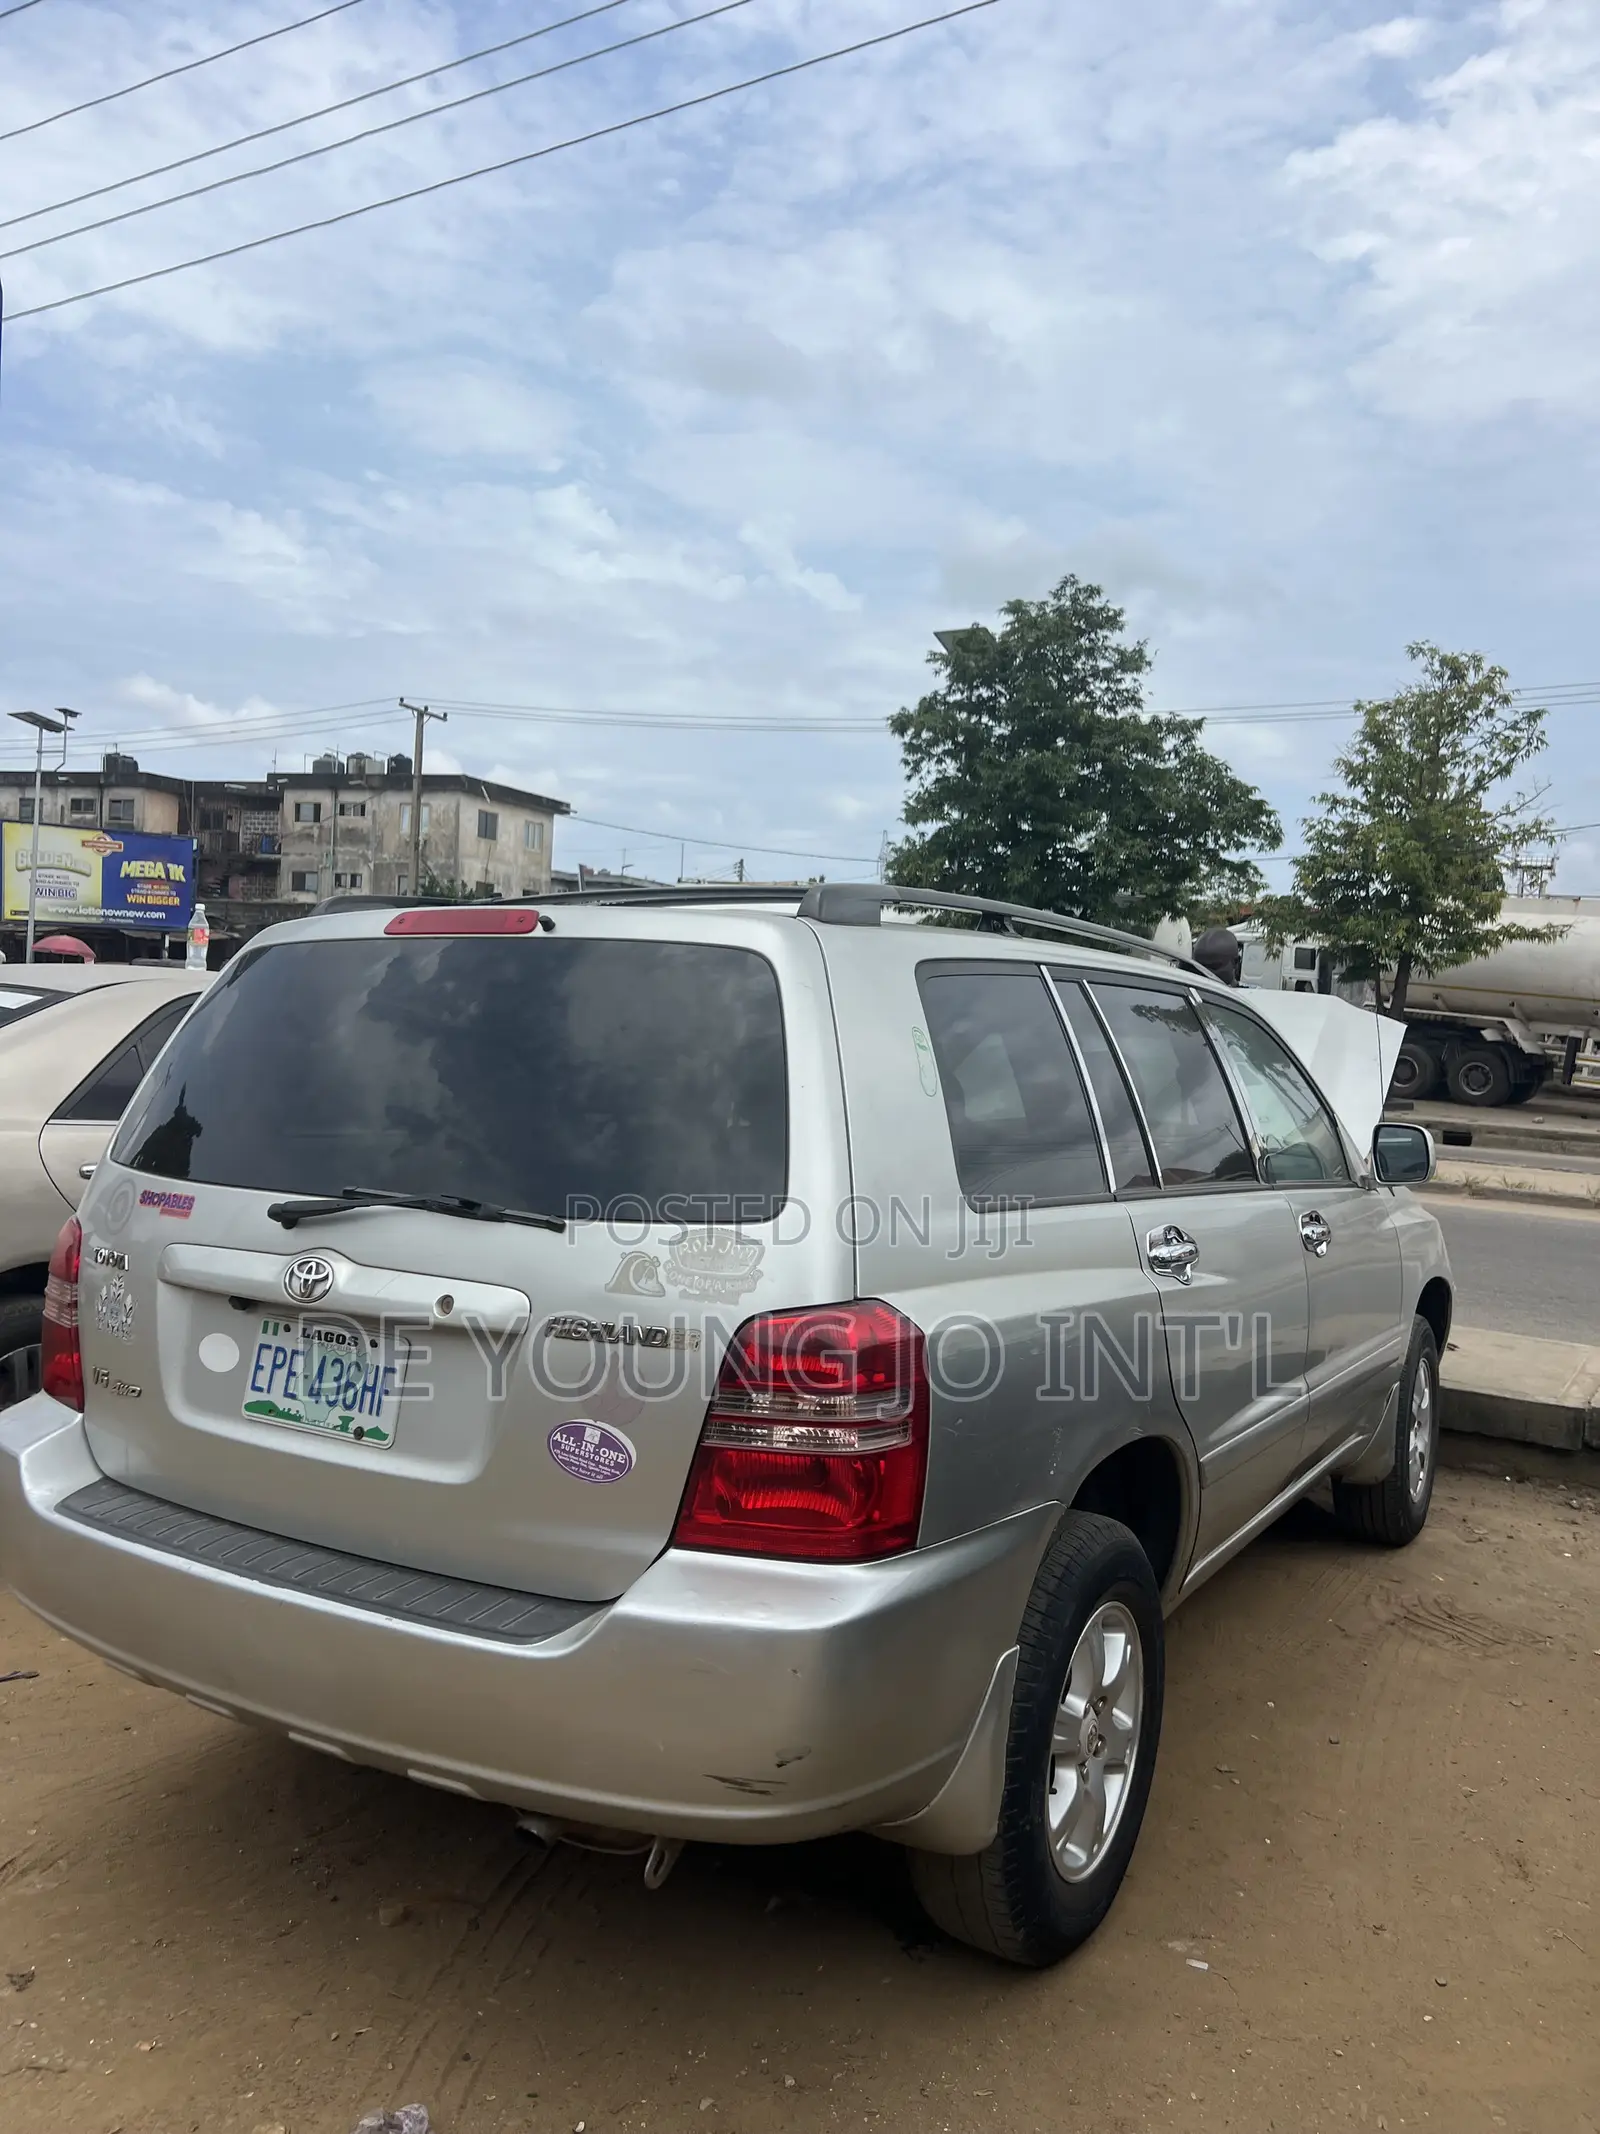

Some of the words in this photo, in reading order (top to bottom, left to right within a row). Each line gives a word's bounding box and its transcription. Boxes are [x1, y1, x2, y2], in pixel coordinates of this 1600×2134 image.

[120, 861, 166, 879] MEGA
[58, 888, 75, 898] BIG
[126, 894, 146, 904] WIN
[147, 895, 180, 906] BIGGER
[48, 905, 166, 919] www.lottonownow.com
[139, 1190, 195, 1211] SHOPABLES
[302, 1328, 359, 1347] LAGOS
[561, 1443, 615, 1467] SUPERSTORES
